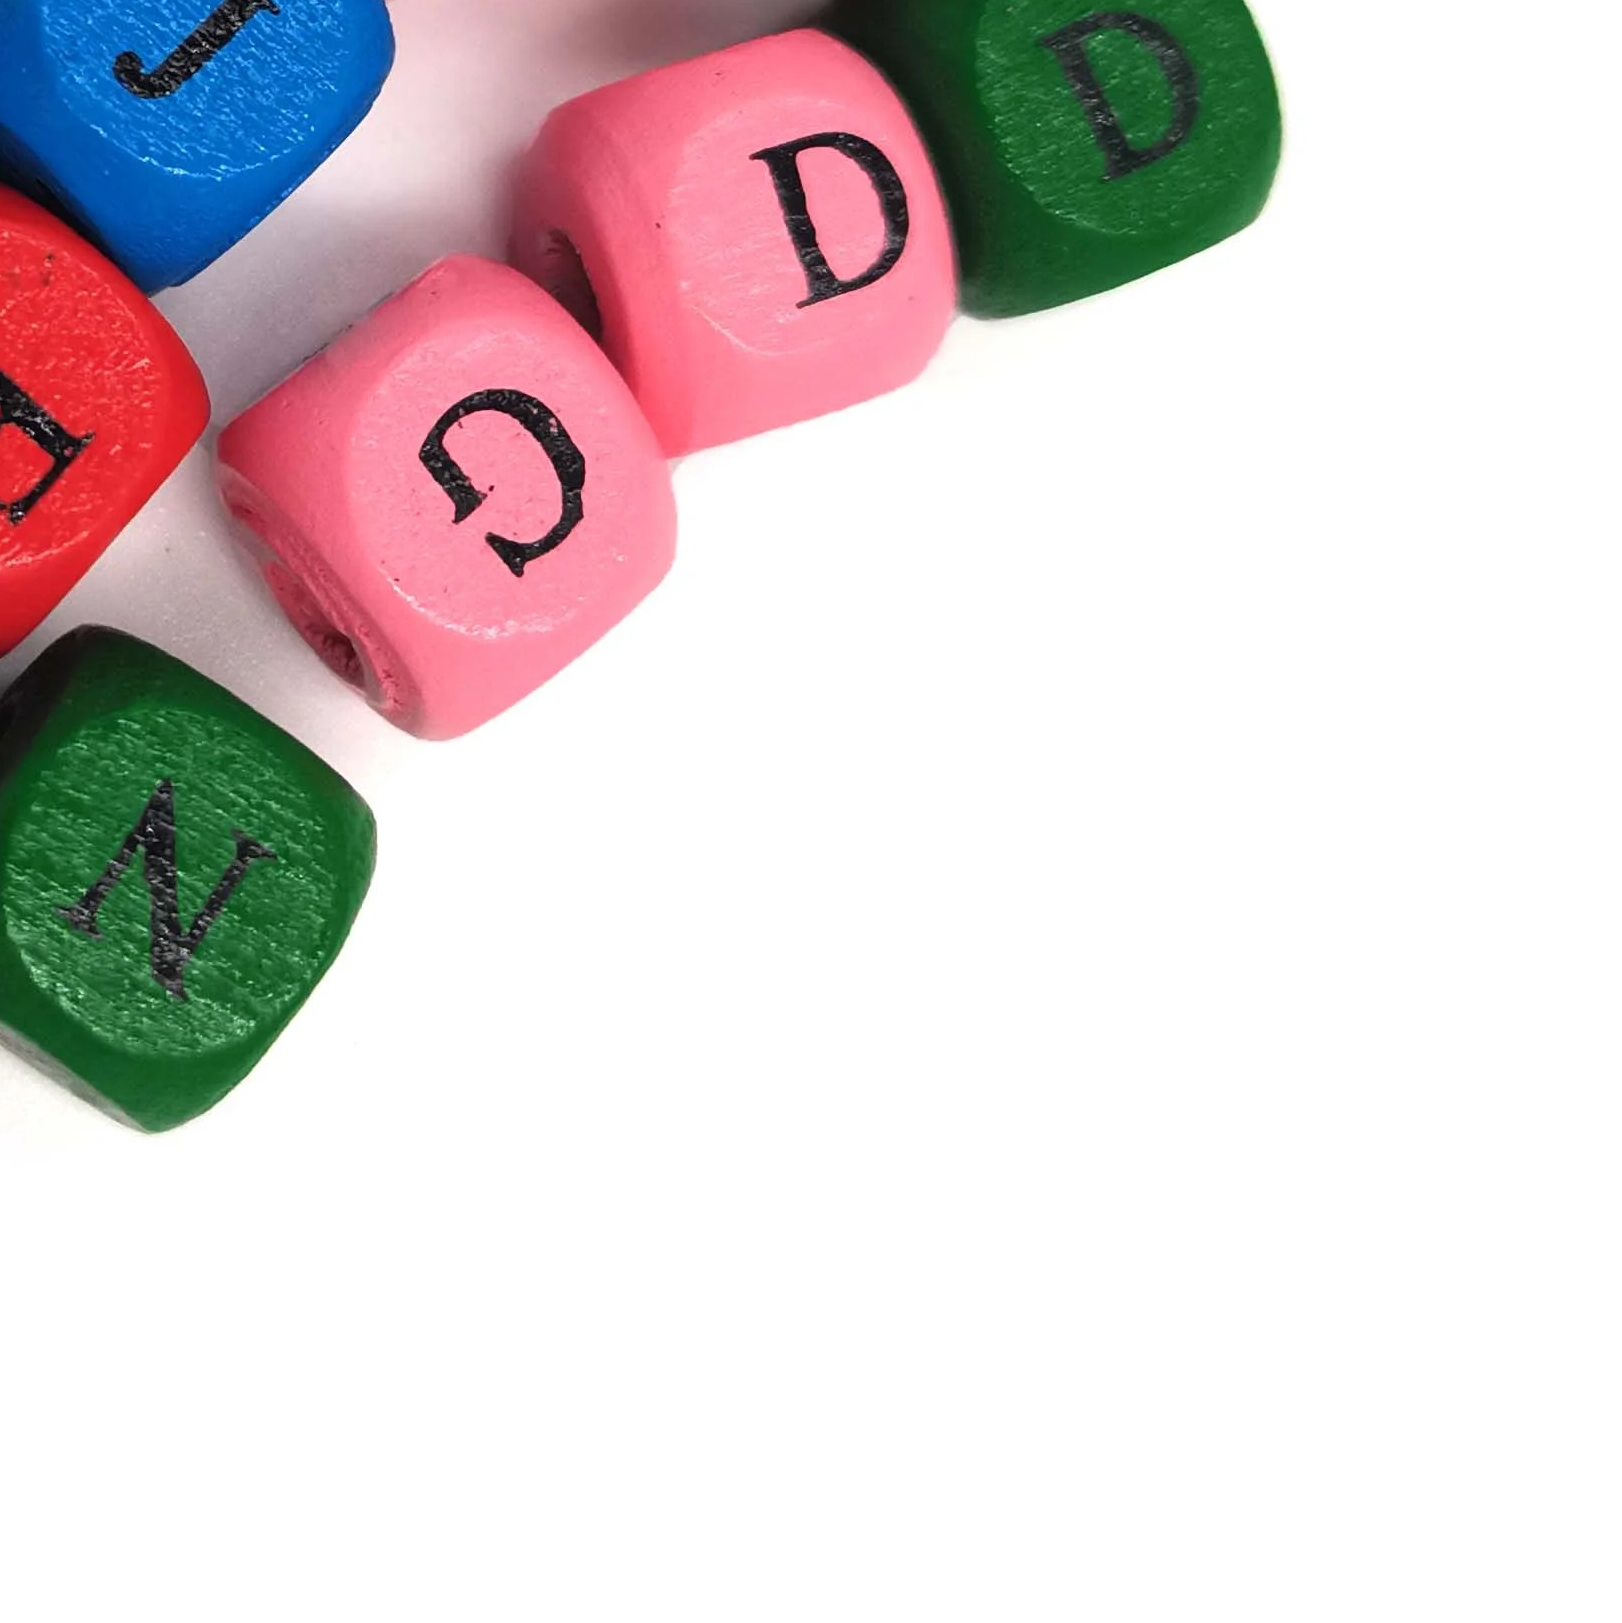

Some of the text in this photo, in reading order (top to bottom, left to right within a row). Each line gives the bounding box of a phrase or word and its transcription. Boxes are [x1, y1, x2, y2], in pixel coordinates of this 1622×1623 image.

[1037, 10, 1203, 184] D
[749, 130, 912, 309] D
[419, 389, 585, 577] G
[54, 778, 278, 1003] N
